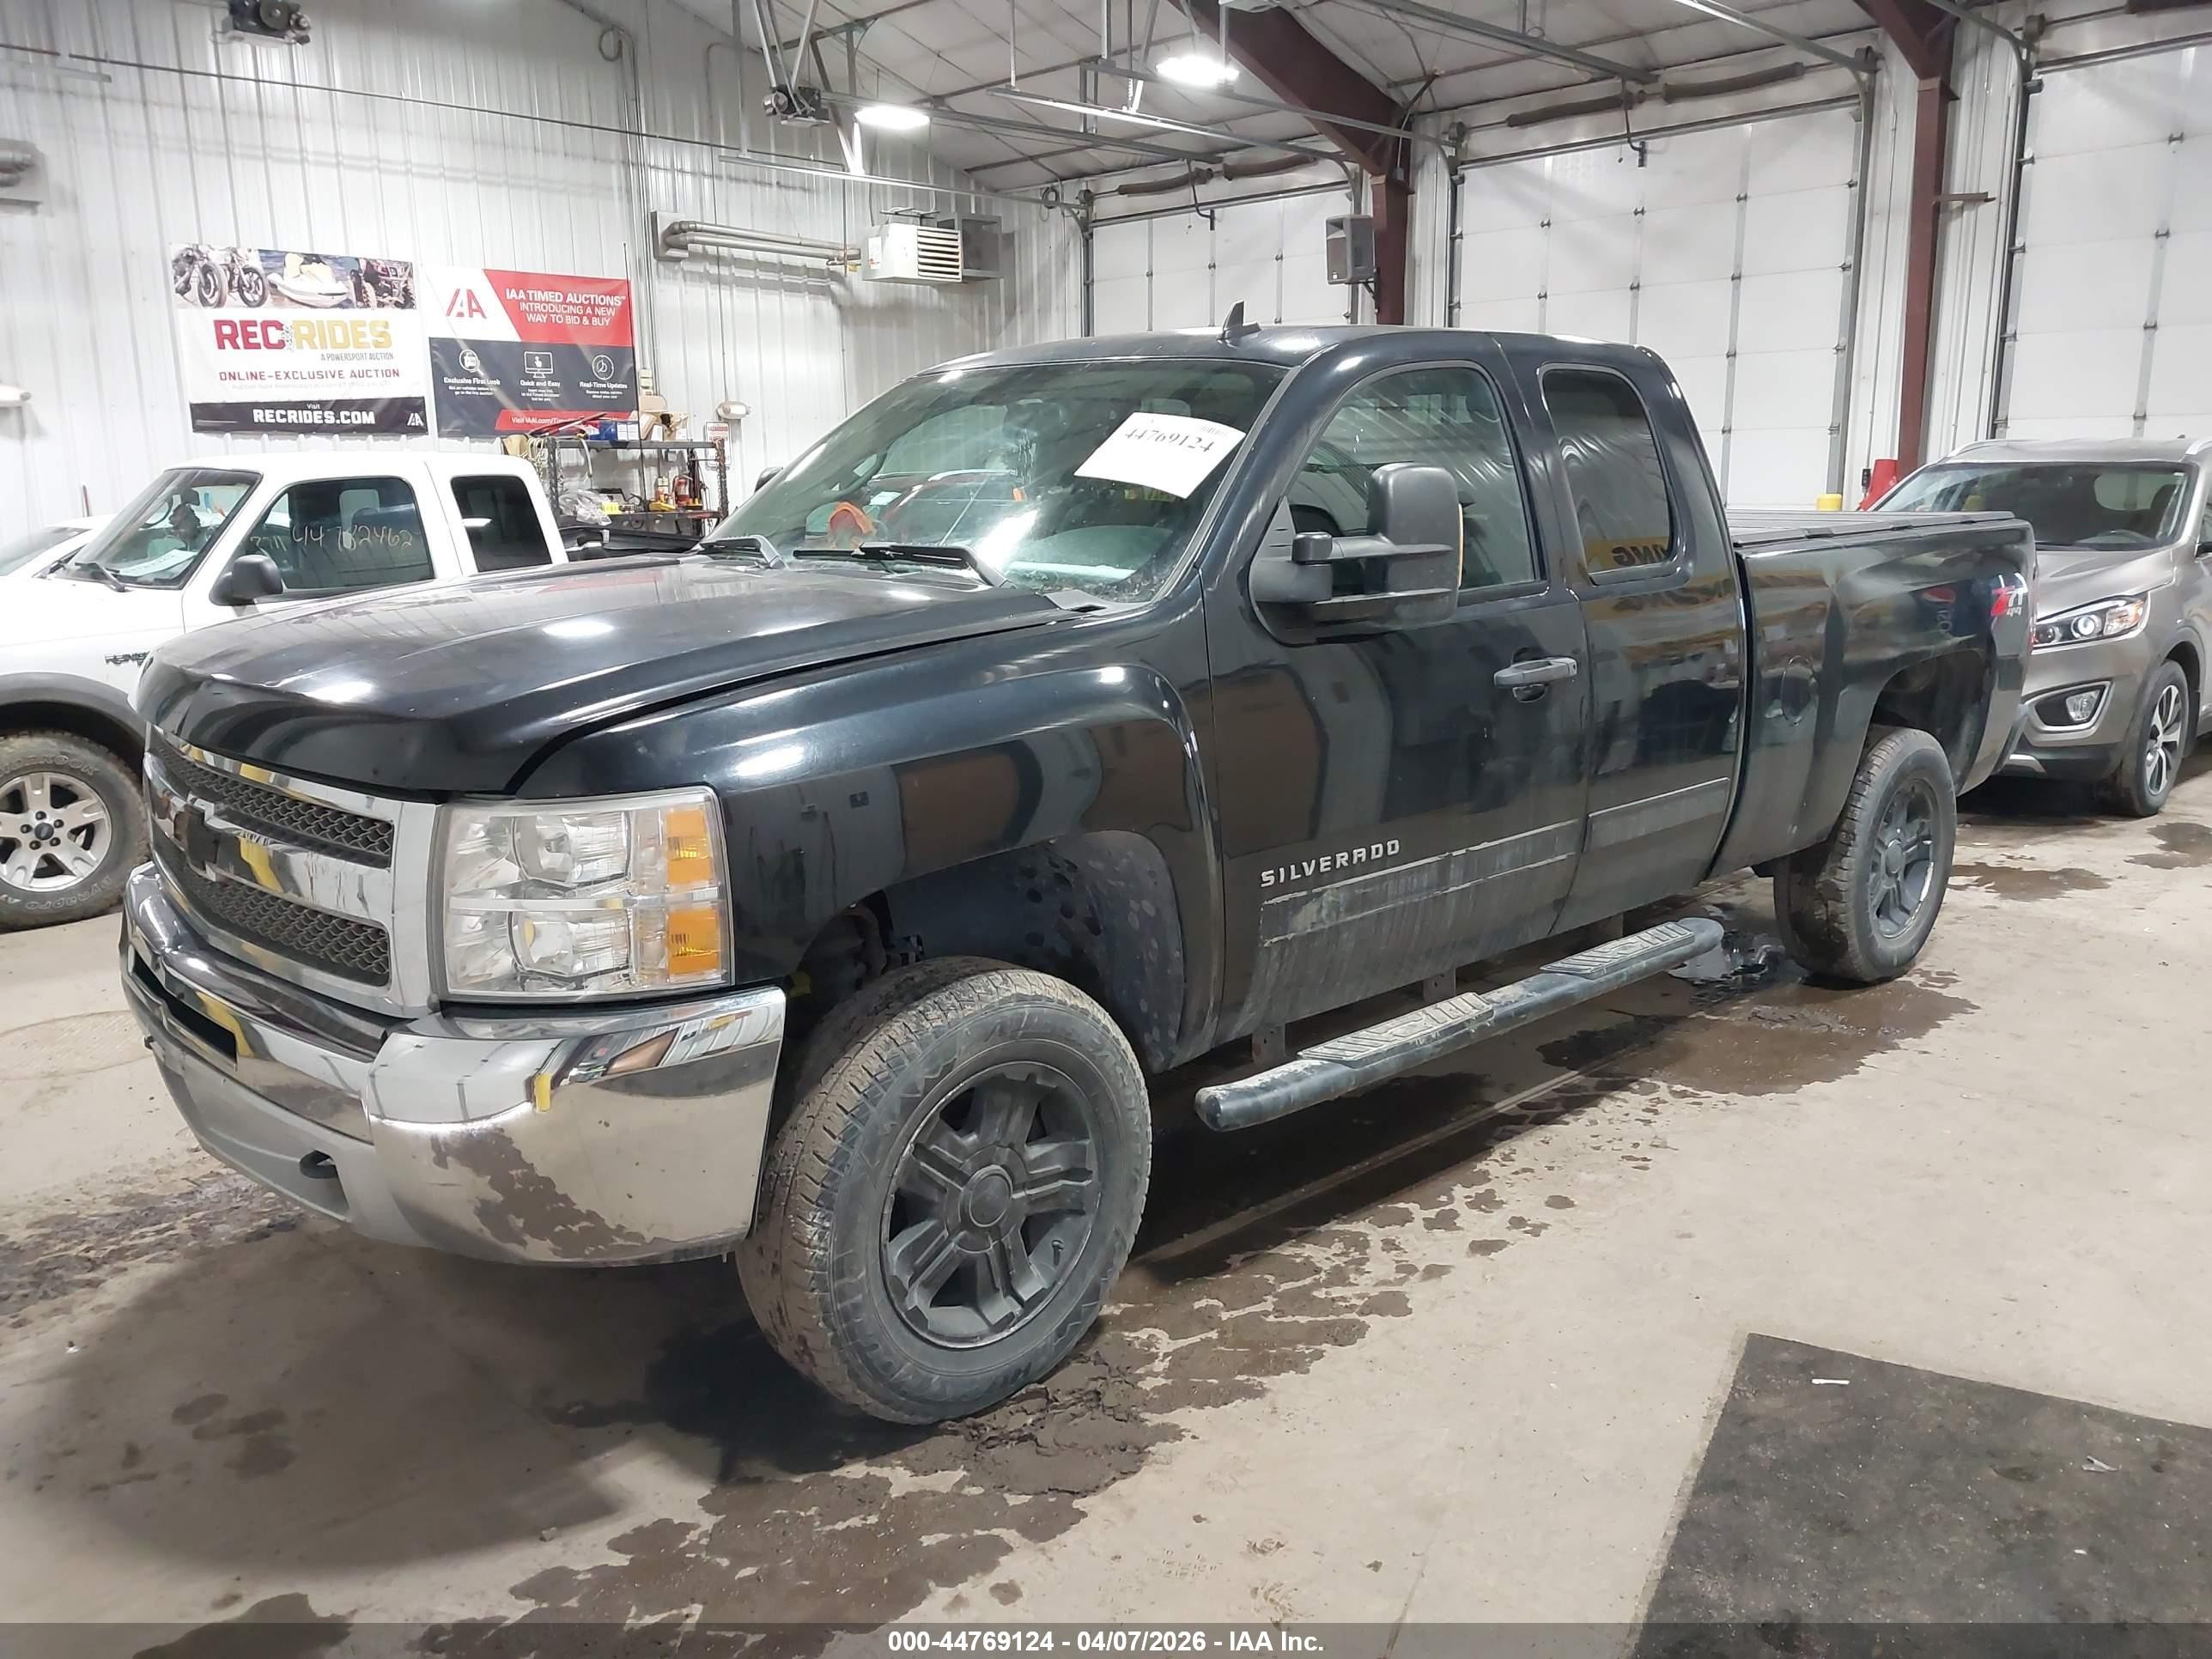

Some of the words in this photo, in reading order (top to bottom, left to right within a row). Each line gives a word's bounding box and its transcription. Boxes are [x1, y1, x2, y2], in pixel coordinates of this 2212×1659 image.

[506, 288, 526, 300] IAA
[526, 290, 563, 302] TIMED
[520, 302, 583, 314] INTRODUCING
[595, 307, 616, 317] NEW
[526, 313, 547, 323] WAY
[550, 314, 563, 324] TO
[566, 315, 580, 325] BID
[582, 316, 589, 325] &
[592, 317, 611, 326] BUY
[213, 319, 286, 349] REC
[292, 319, 392, 349] RIDES
[326, 352, 368, 361] POWERSPORT
[369, 352, 393, 361] AUCTION
[220, 370, 344, 380] ONLINE-EXCLUSIVE
[350, 368, 399, 379] AUCTION
[252, 409, 375, 424] RECRIDES.COM
[1261, 839, 1400, 888] SILVERADO
